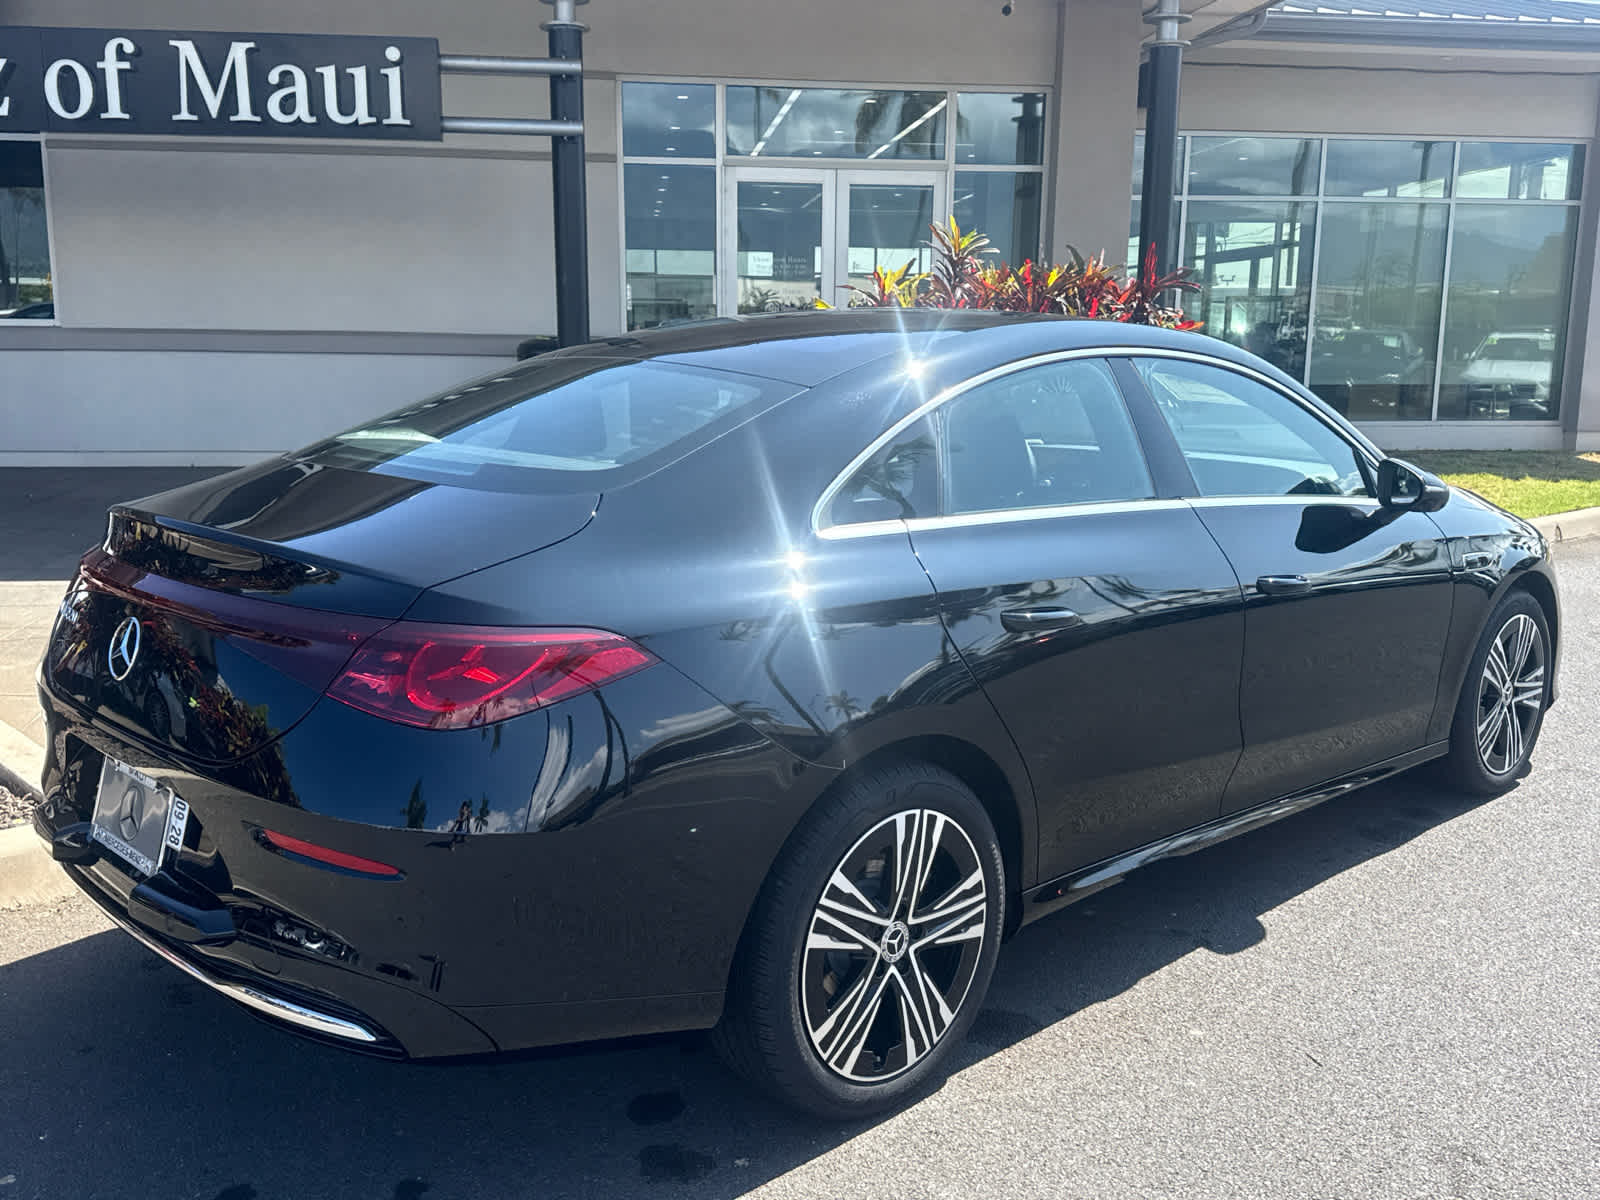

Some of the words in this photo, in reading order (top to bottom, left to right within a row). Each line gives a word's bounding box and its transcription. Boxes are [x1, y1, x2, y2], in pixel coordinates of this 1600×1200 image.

[44, 37, 136, 121] of
[168, 39, 412, 126] Maui
[174, 800, 187, 821] 09
[169, 826, 182, 846] 28
